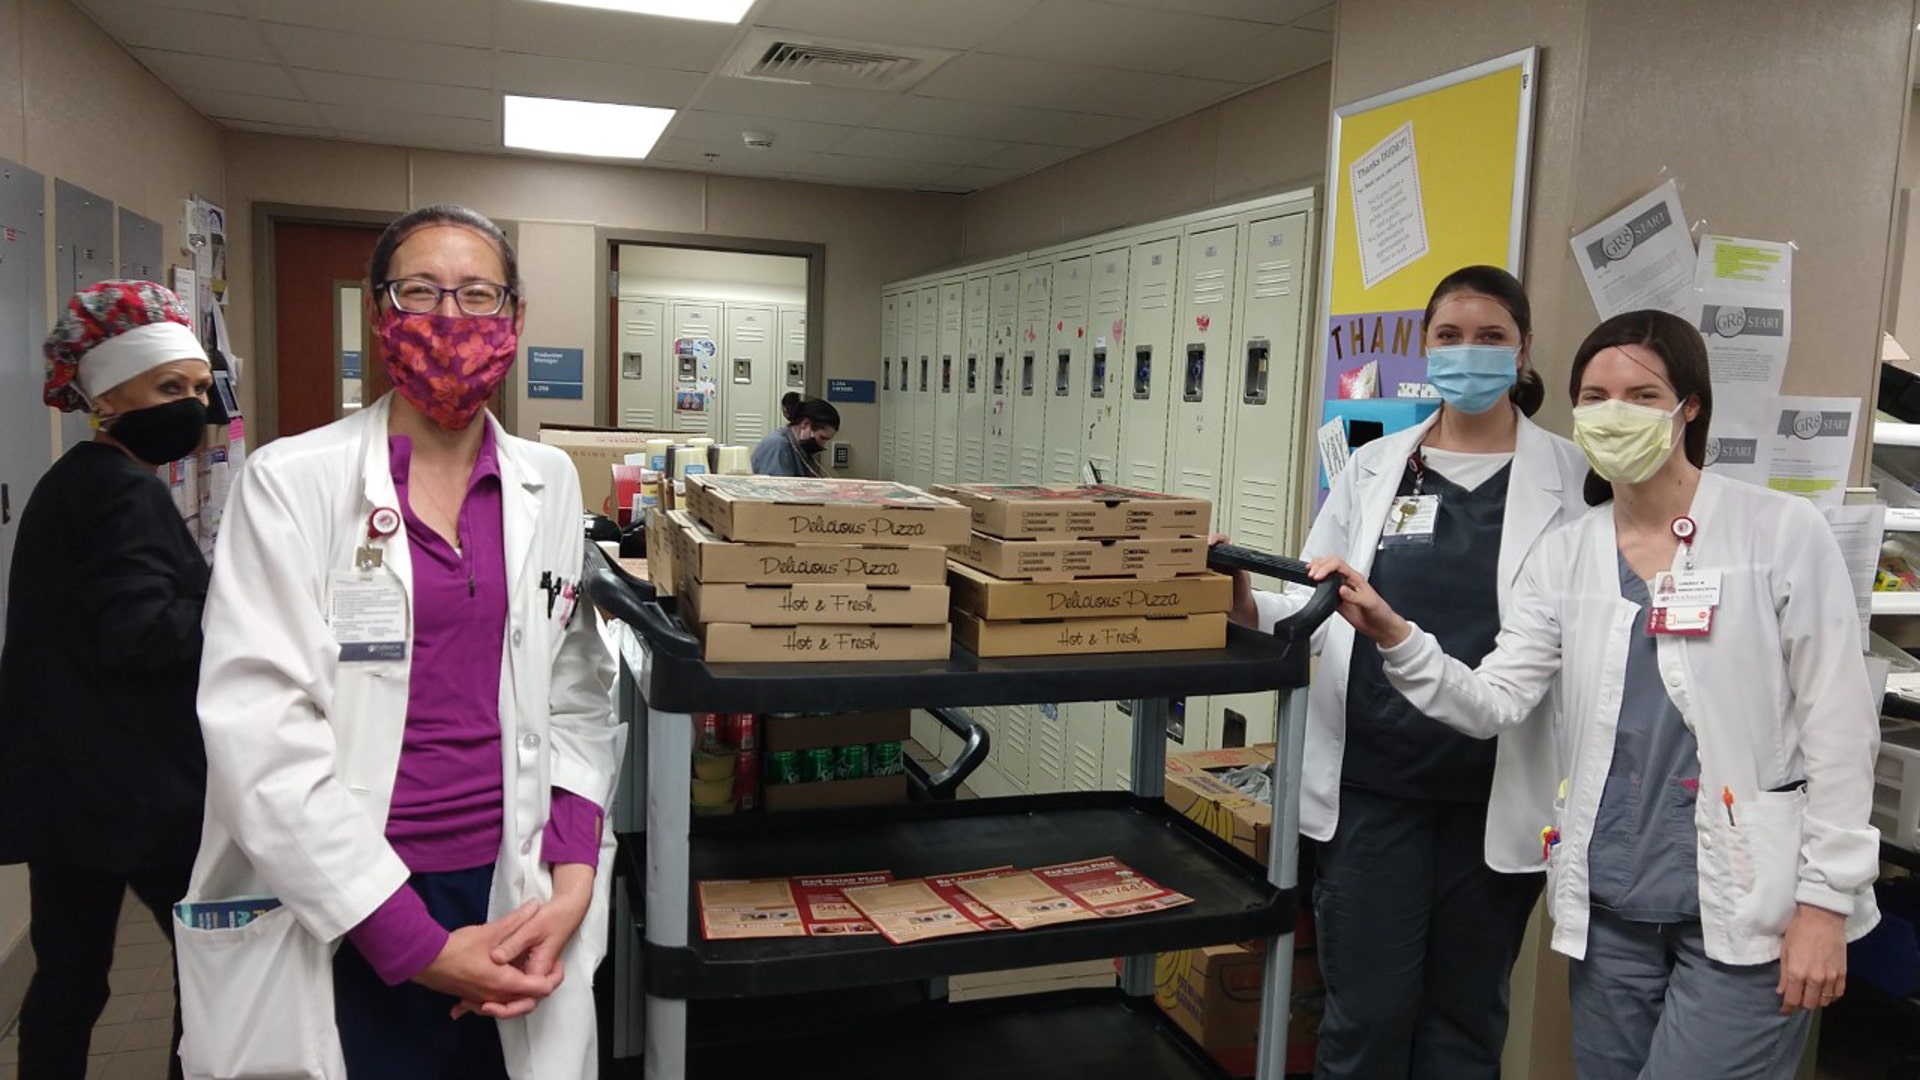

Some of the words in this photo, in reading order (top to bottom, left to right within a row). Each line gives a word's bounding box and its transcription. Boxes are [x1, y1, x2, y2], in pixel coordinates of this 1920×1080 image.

[1357, 157, 1381, 179] Thanks
[1606, 228, 1633, 257] GR8
[1634, 212, 1664, 236] START
[1717, 311, 1744, 331] GR8
[1748, 316, 1779, 329] START
[1795, 414, 1821, 433] GR8
[1823, 419, 1848, 430] START
[1703, 443, 1720, 457] R8
[1722, 446, 1752, 457] START
[789, 514, 866, 535] Delicious
[868, 516, 926, 536] Pizza
[759, 555, 839, 576] Delicious
[840, 556, 900, 576] Pizza
[777, 591, 809, 612] Hot
[815, 599, 826, 612] &
[830, 593, 877, 613] Fresh
[1046, 590, 1121, 611] Delicious
[1123, 589, 1180, 608] Pizza
[782, 630, 813, 651] Hot
[818, 638, 830, 651] &
[833, 631, 880, 650] Fresh
[1057, 627, 1082, 647] Hot
[1088, 635, 1098, 646] &
[1101, 626, 1143, 645] Fresh
[1043, 869, 1063, 877] Red
[1090, 861, 1117, 870] Pizza
[816, 904, 850, 912] 584
